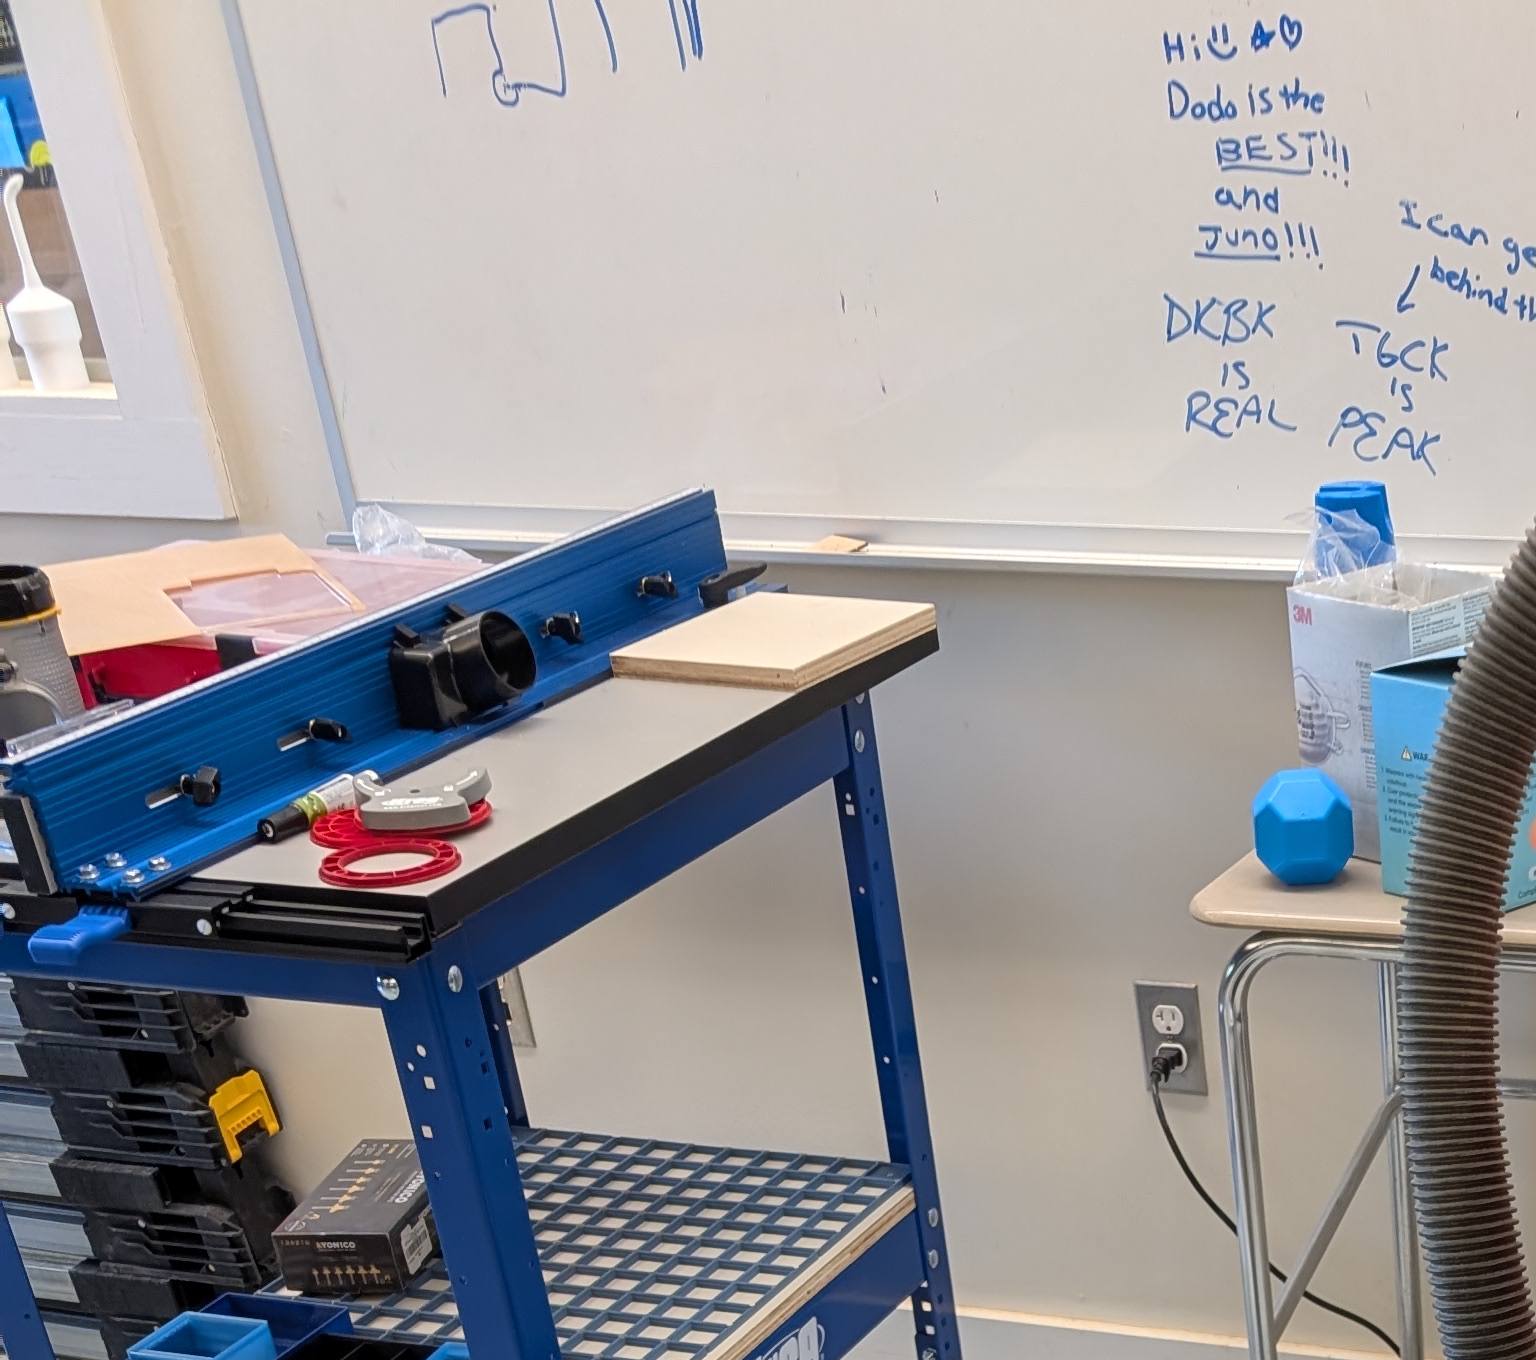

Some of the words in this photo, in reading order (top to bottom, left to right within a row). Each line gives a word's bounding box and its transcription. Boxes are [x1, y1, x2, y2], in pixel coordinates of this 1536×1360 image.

[1163, 32, 1201, 64] Hi
[1168, 79, 1238, 122] Dodo
[1247, 83, 1273, 117] is
[1279, 77, 1326, 115] the
[1215, 130, 1351, 188] BEST!!!
[1215, 186, 1280, 213] and
[1399, 200, 1422, 231] I
[1427, 213, 1489, 247] can
[1430, 256, 1509, 316] behind
[1164, 294, 1277, 347] DKBK
[1185, 390, 1298, 440] REAL
[1327, 406, 1442, 476] PEAK
[1293, 605, 1312, 625] 3M
